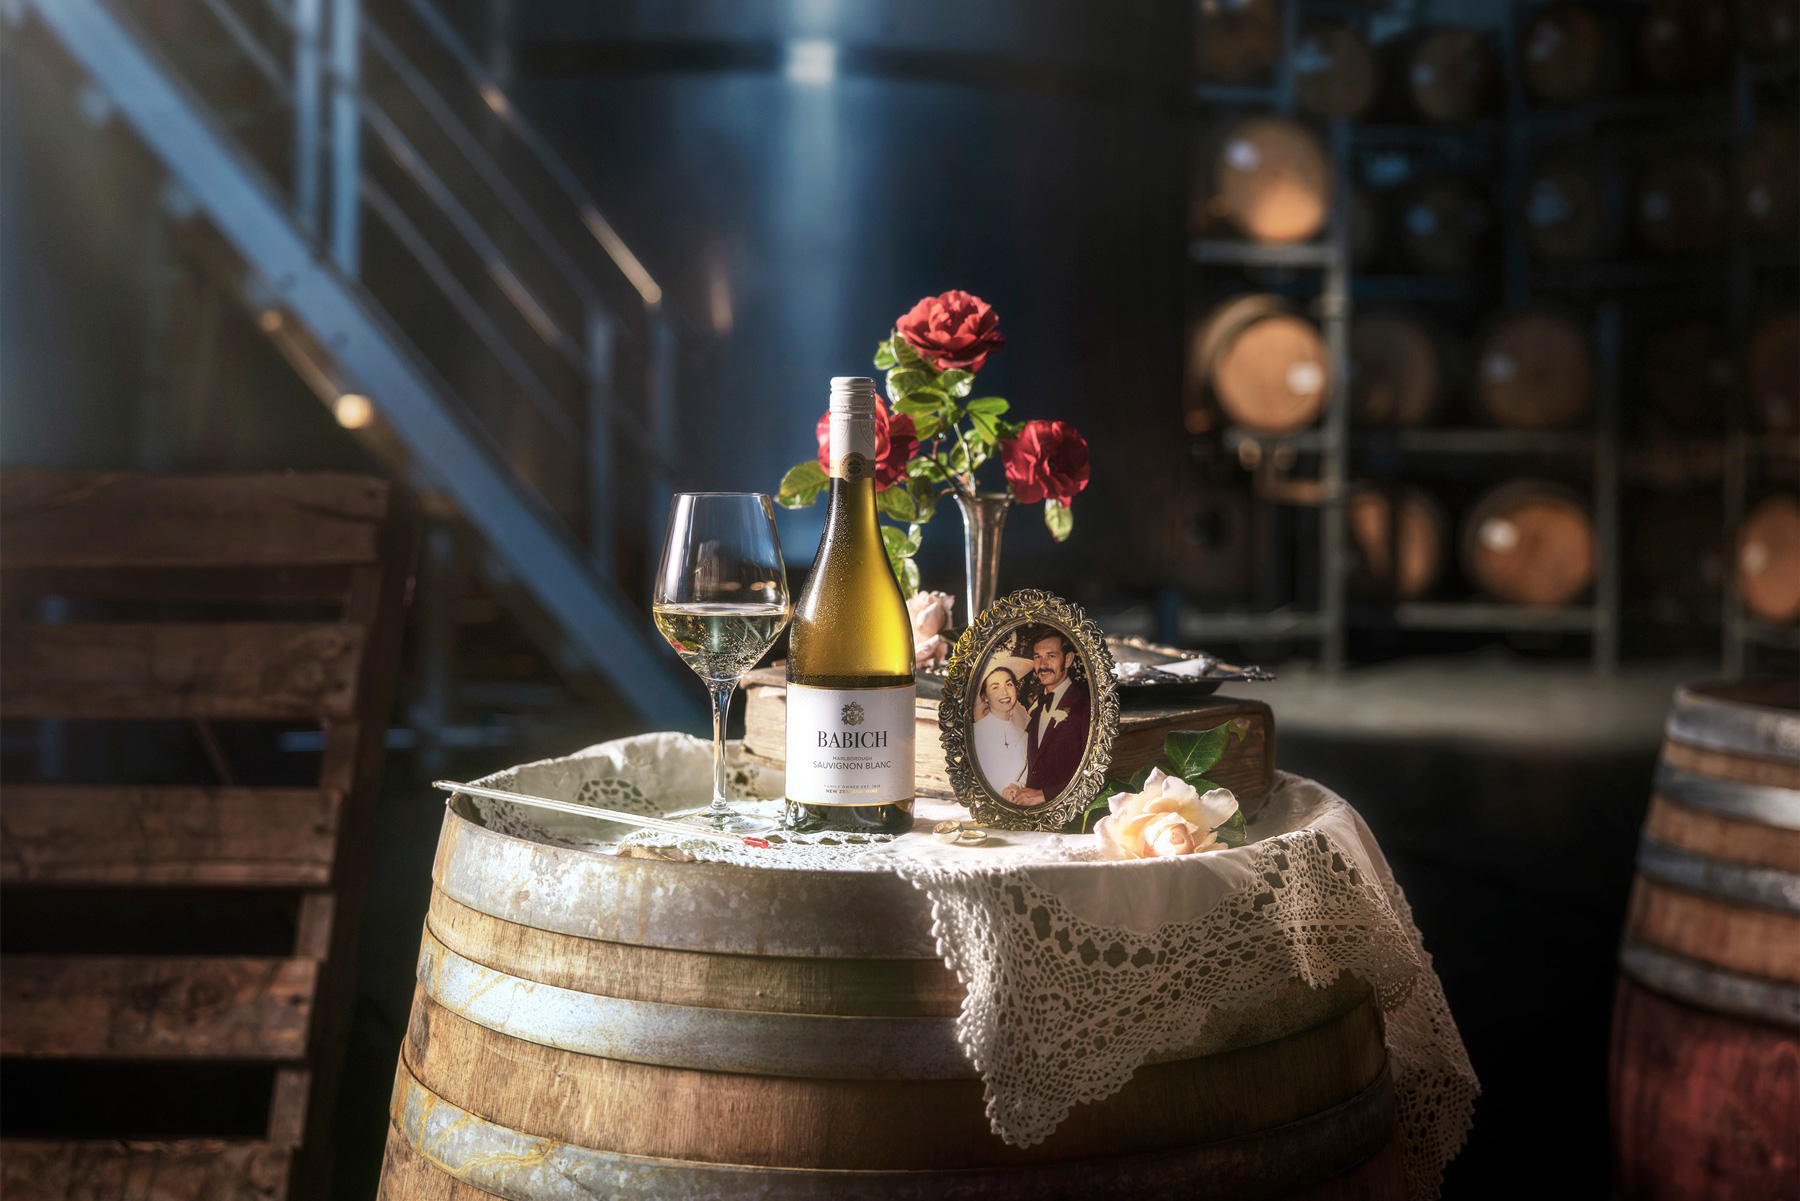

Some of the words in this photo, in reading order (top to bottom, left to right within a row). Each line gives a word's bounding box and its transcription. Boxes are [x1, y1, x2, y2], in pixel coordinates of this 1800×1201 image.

[817, 731, 888, 748] BABICH
[813, 761, 863, 770] SAUVIGNON
[865, 761, 892, 769] BLANC
